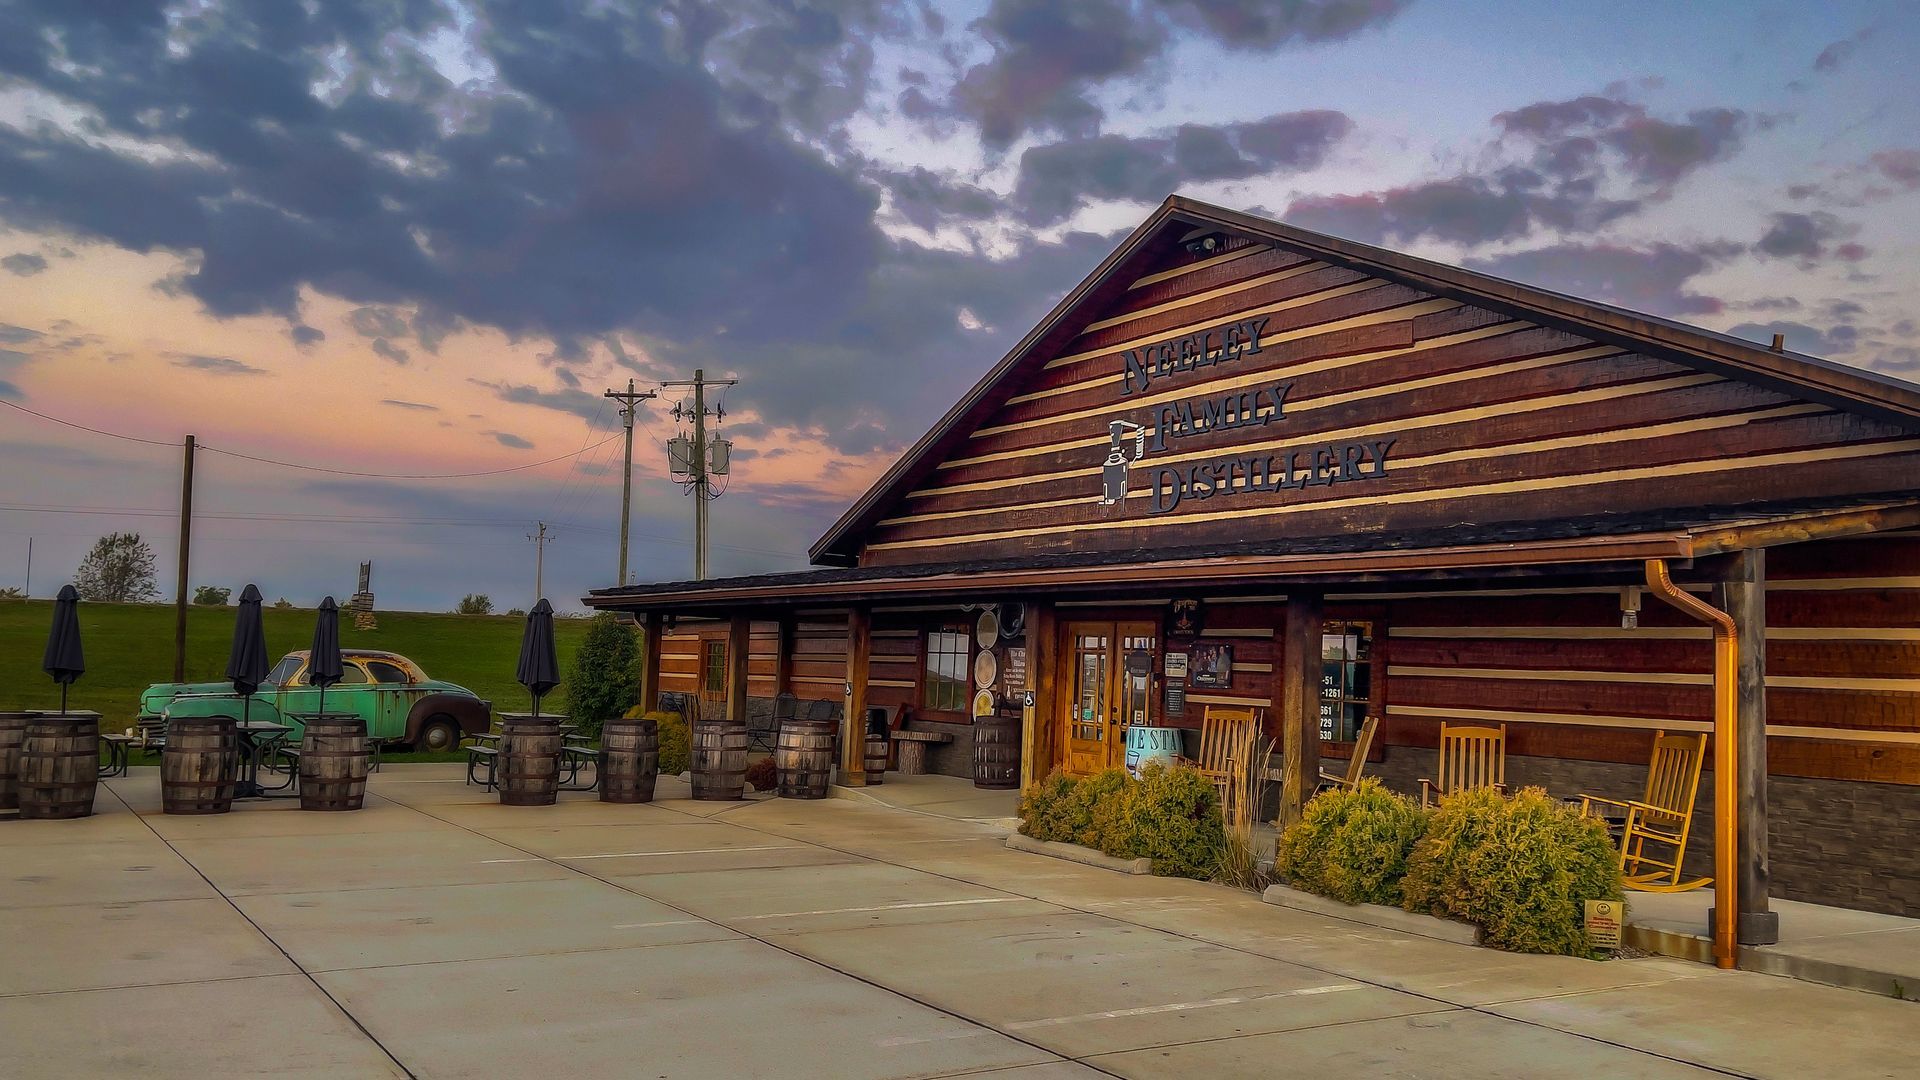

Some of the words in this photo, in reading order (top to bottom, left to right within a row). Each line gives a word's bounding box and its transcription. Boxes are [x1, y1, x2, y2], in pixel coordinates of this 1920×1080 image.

[1120, 316, 1271, 395] NEELEY
[1149, 382, 1294, 453] FAMILY
[1145, 438, 1397, 514] DISTILLERY
